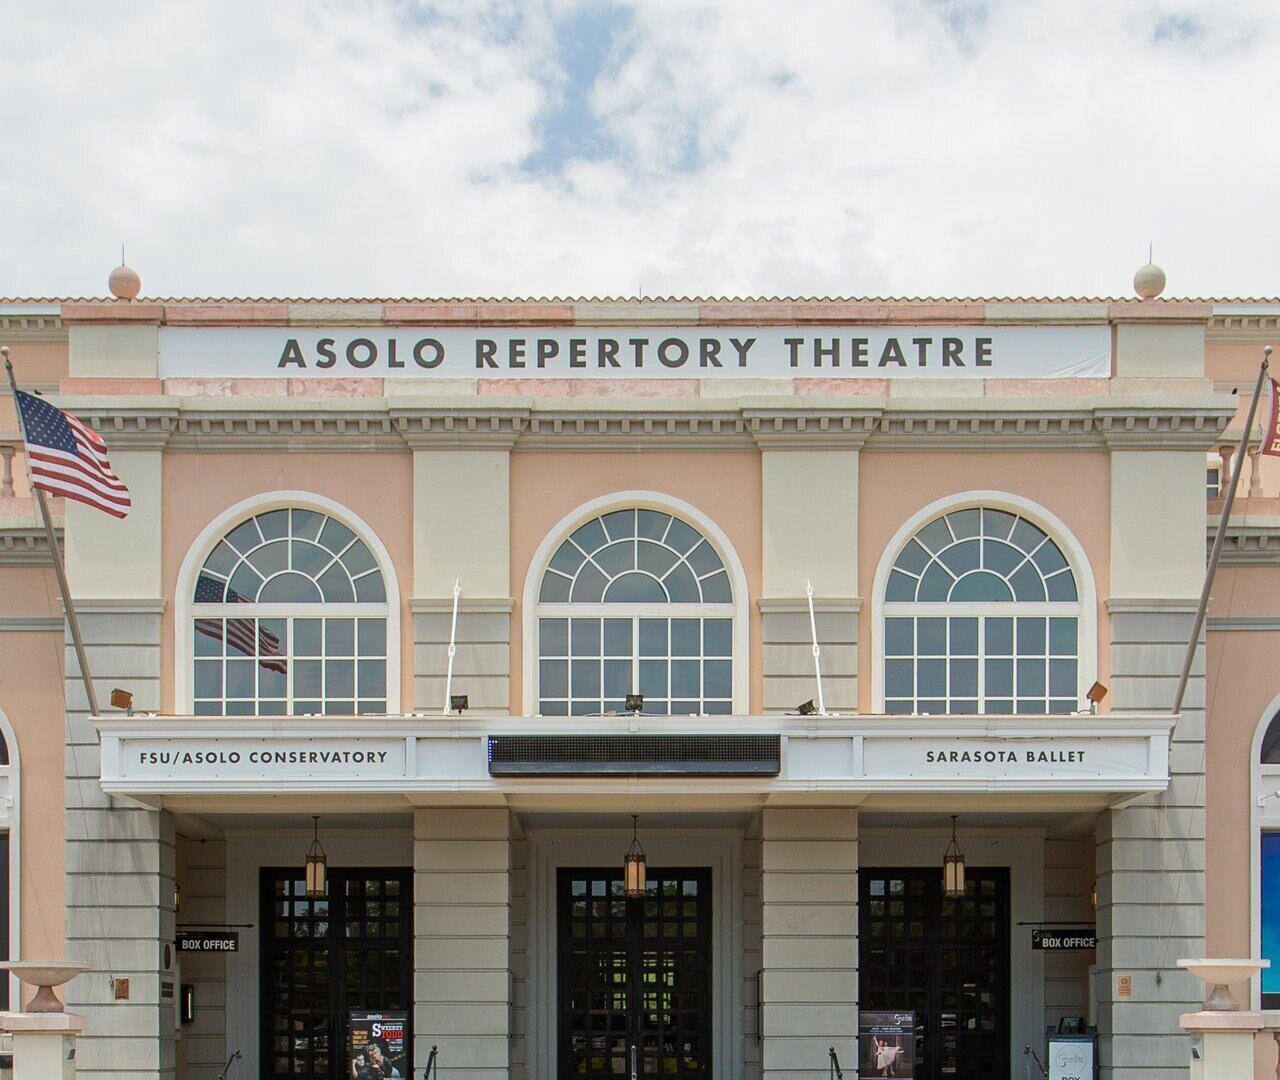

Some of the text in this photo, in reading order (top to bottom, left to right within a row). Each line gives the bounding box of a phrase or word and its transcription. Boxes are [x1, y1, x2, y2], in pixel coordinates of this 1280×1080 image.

[277, 337, 996, 370] ASOLO REPERTORY THEATRE
[139, 750, 390, 766] FSU/ASOLO CONSERVATORY
[926, 750, 1086, 763] SARASOTA BALLET
[182, 939, 236, 950] BOX OFFICE
[1042, 937, 1095, 948] BOX OFFICE
